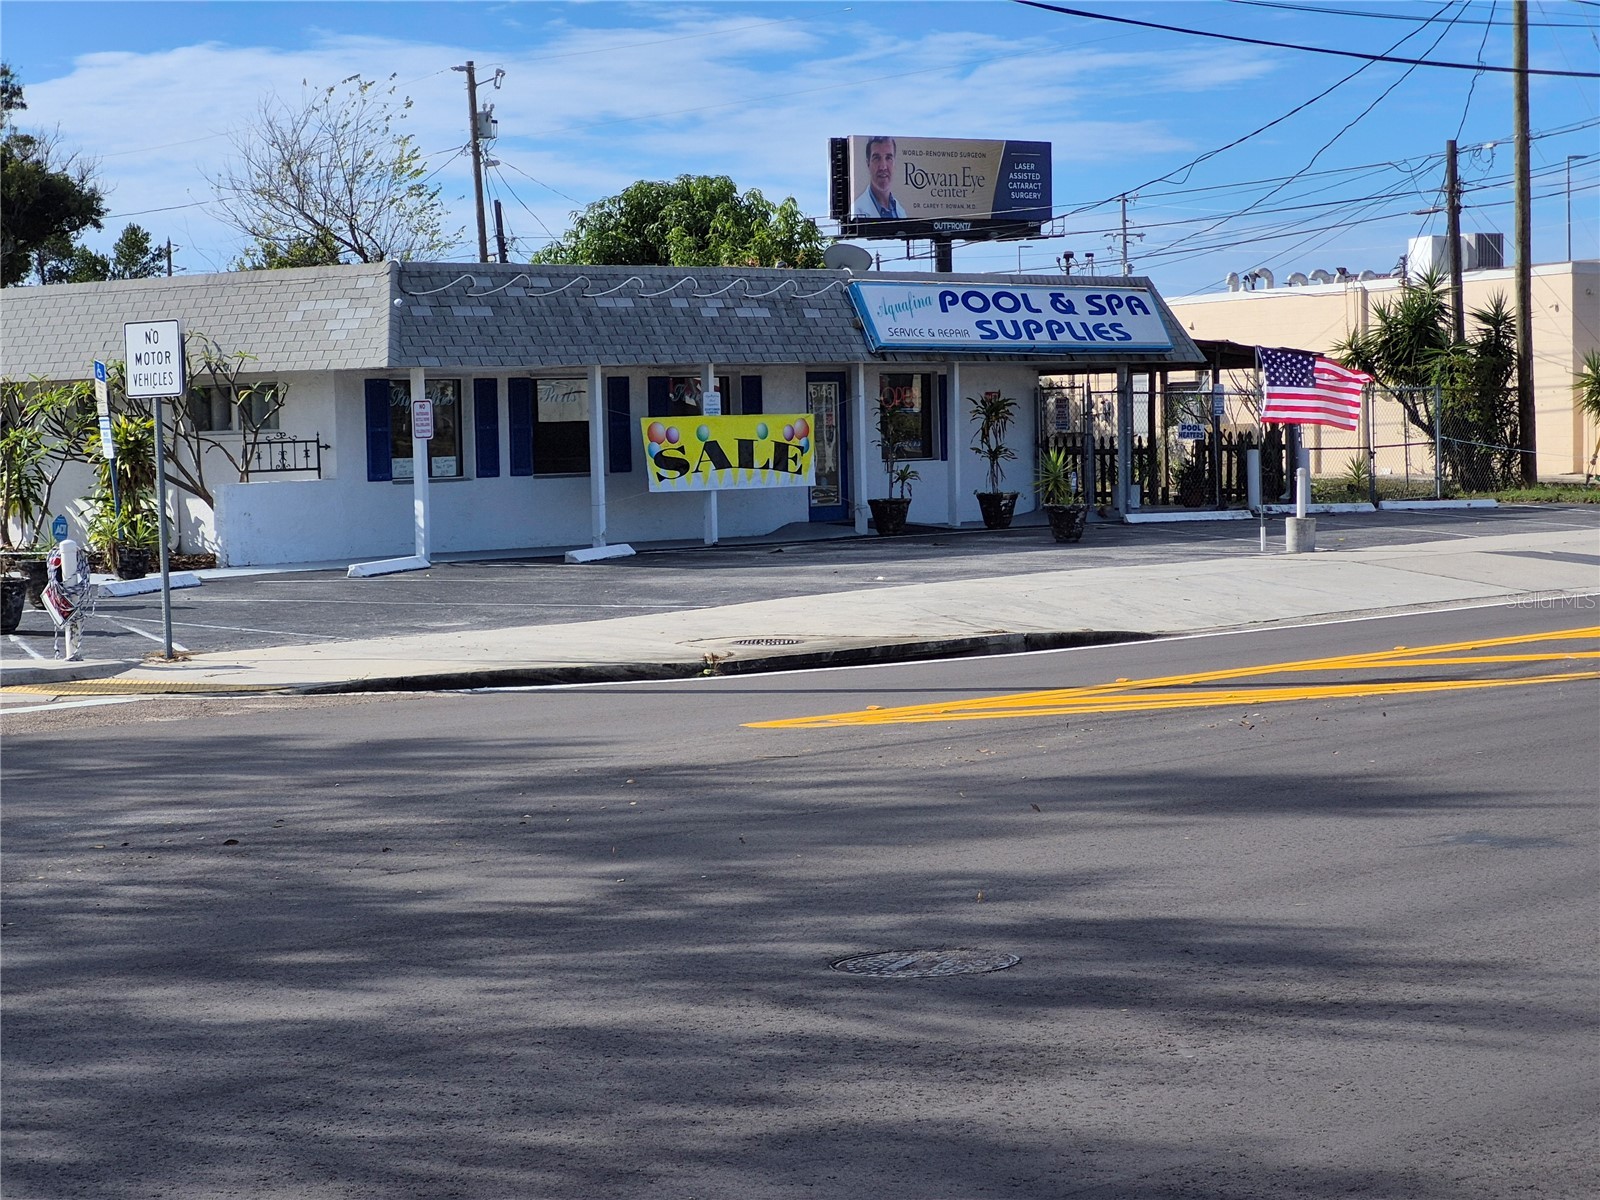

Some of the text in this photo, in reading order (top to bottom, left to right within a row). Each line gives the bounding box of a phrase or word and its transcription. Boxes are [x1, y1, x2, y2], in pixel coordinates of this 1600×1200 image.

[902, 150, 958, 158] WORLD-RENOWNED
[904, 162, 986, 193] Rowan Eye
[1009, 172, 1041, 180] ASSISTED
[930, 187, 968, 198] center
[1008, 182, 1042, 190] CATARACT
[1011, 191, 1042, 199] SURGERY
[877, 290, 1151, 322] Aquafina POOL & SPA
[145, 330, 159, 344] NO
[888, 319, 1132, 341] SERVICE & REPAIR SUPPLIES
[135, 350, 171, 366] MOTOR
[133, 371, 174, 387] VEHICLES
[1178, 431, 1204, 439] HEATERS
[653, 438, 805, 482] SALE
